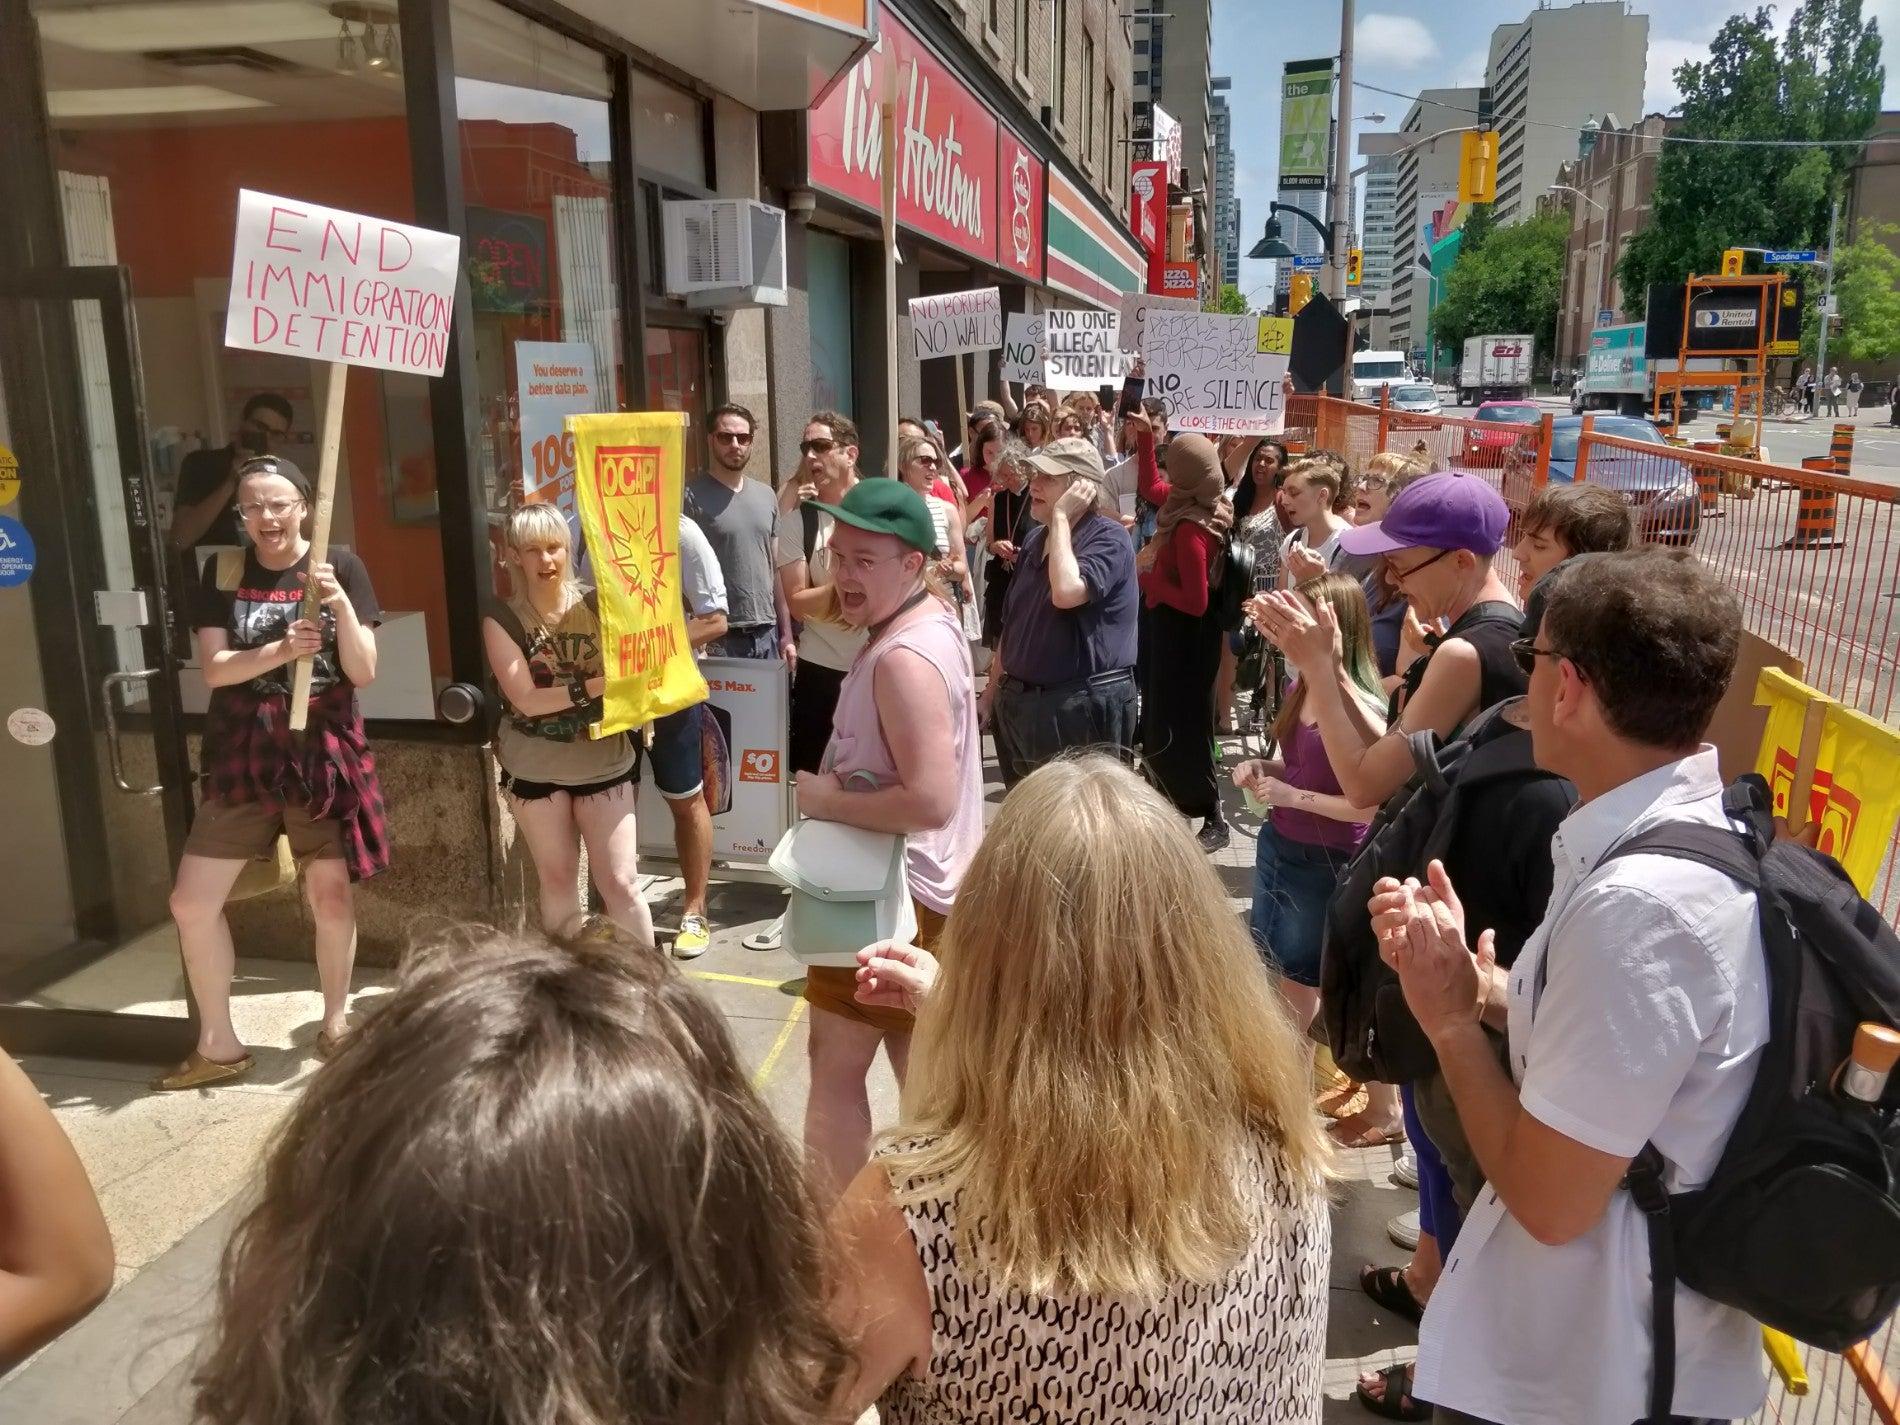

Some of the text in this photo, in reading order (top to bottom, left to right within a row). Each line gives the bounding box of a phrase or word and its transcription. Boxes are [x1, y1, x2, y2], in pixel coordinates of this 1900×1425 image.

[1287, 84, 1309, 96] the
[902, 57, 981, 238] Hortons
[266, 206, 413, 272] END
[1771, 253, 1800, 262] Spadina
[246, 260, 452, 334] IMMIGRATION
[911, 290, 1000, 322] NO BORDERS
[1049, 311, 1075, 330] NO
[1083, 312, 1116, 330] ONE
[1721, 318, 1754, 326] Rentals
[253, 306, 446, 369] DETENTION
[914, 314, 1001, 357] NO WALLS
[1050, 332, 1111, 353] ILLEGAL
[1006, 342, 1035, 366] NO
[1492, 344, 1523, 357] Erb
[533, 363, 584, 377] You deserve a
[1051, 354, 1105, 378] STOLEN
[528, 382, 554, 396] better
[554, 381, 571, 395] data
[1149, 373, 1181, 396] NO
[1161, 379, 1281, 418] ORE SILENCE
[1180, 416, 1210, 430] CLOSE
[1217, 416, 1236, 432] THE
[602, 457, 655, 498] OCAP
[133, 489, 143, 517] PUSH
[620, 628, 656, 678] FIGHT
[732, 842, 773, 854] Freedom
